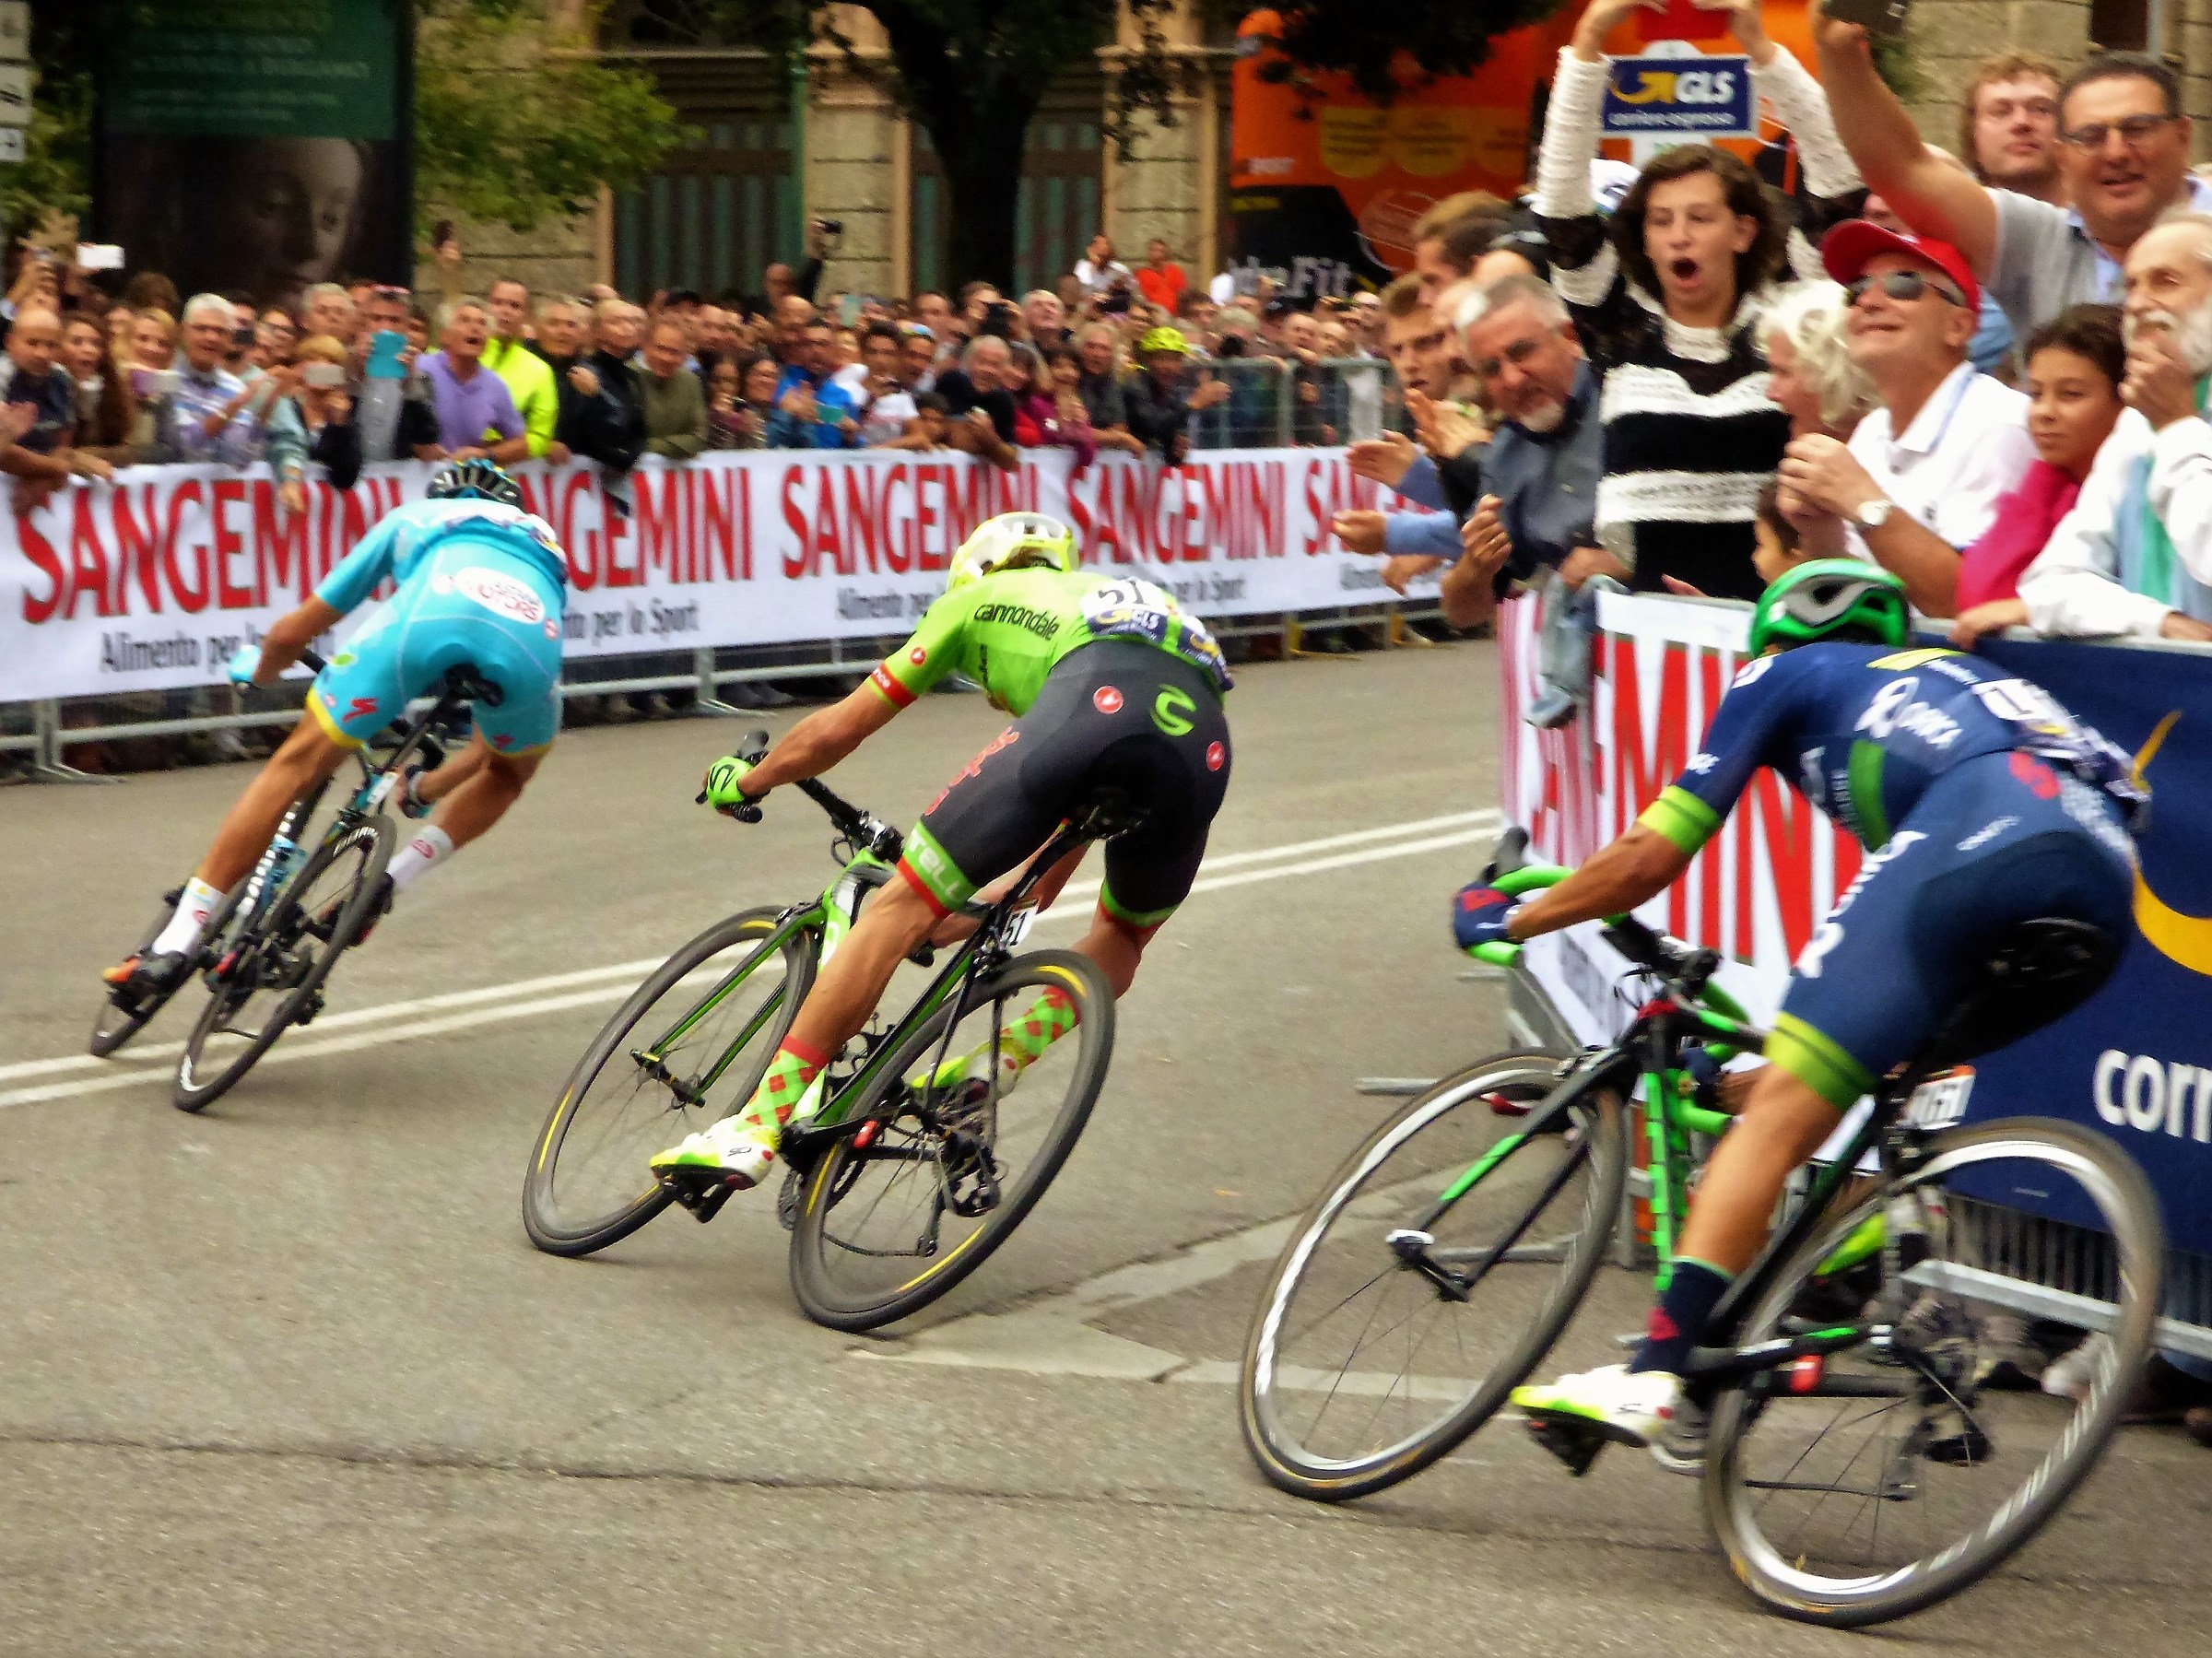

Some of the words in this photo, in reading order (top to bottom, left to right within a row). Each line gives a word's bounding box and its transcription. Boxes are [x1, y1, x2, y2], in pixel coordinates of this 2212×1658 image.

[1676, 70, 1735, 105] GLS
[16, 476, 403, 625] SANGEMIN
[516, 467, 753, 593] GEMINI
[1066, 461, 1287, 565] SANGEMINI
[649, 596, 700, 643] Sport
[973, 602, 1060, 641] cannondale
